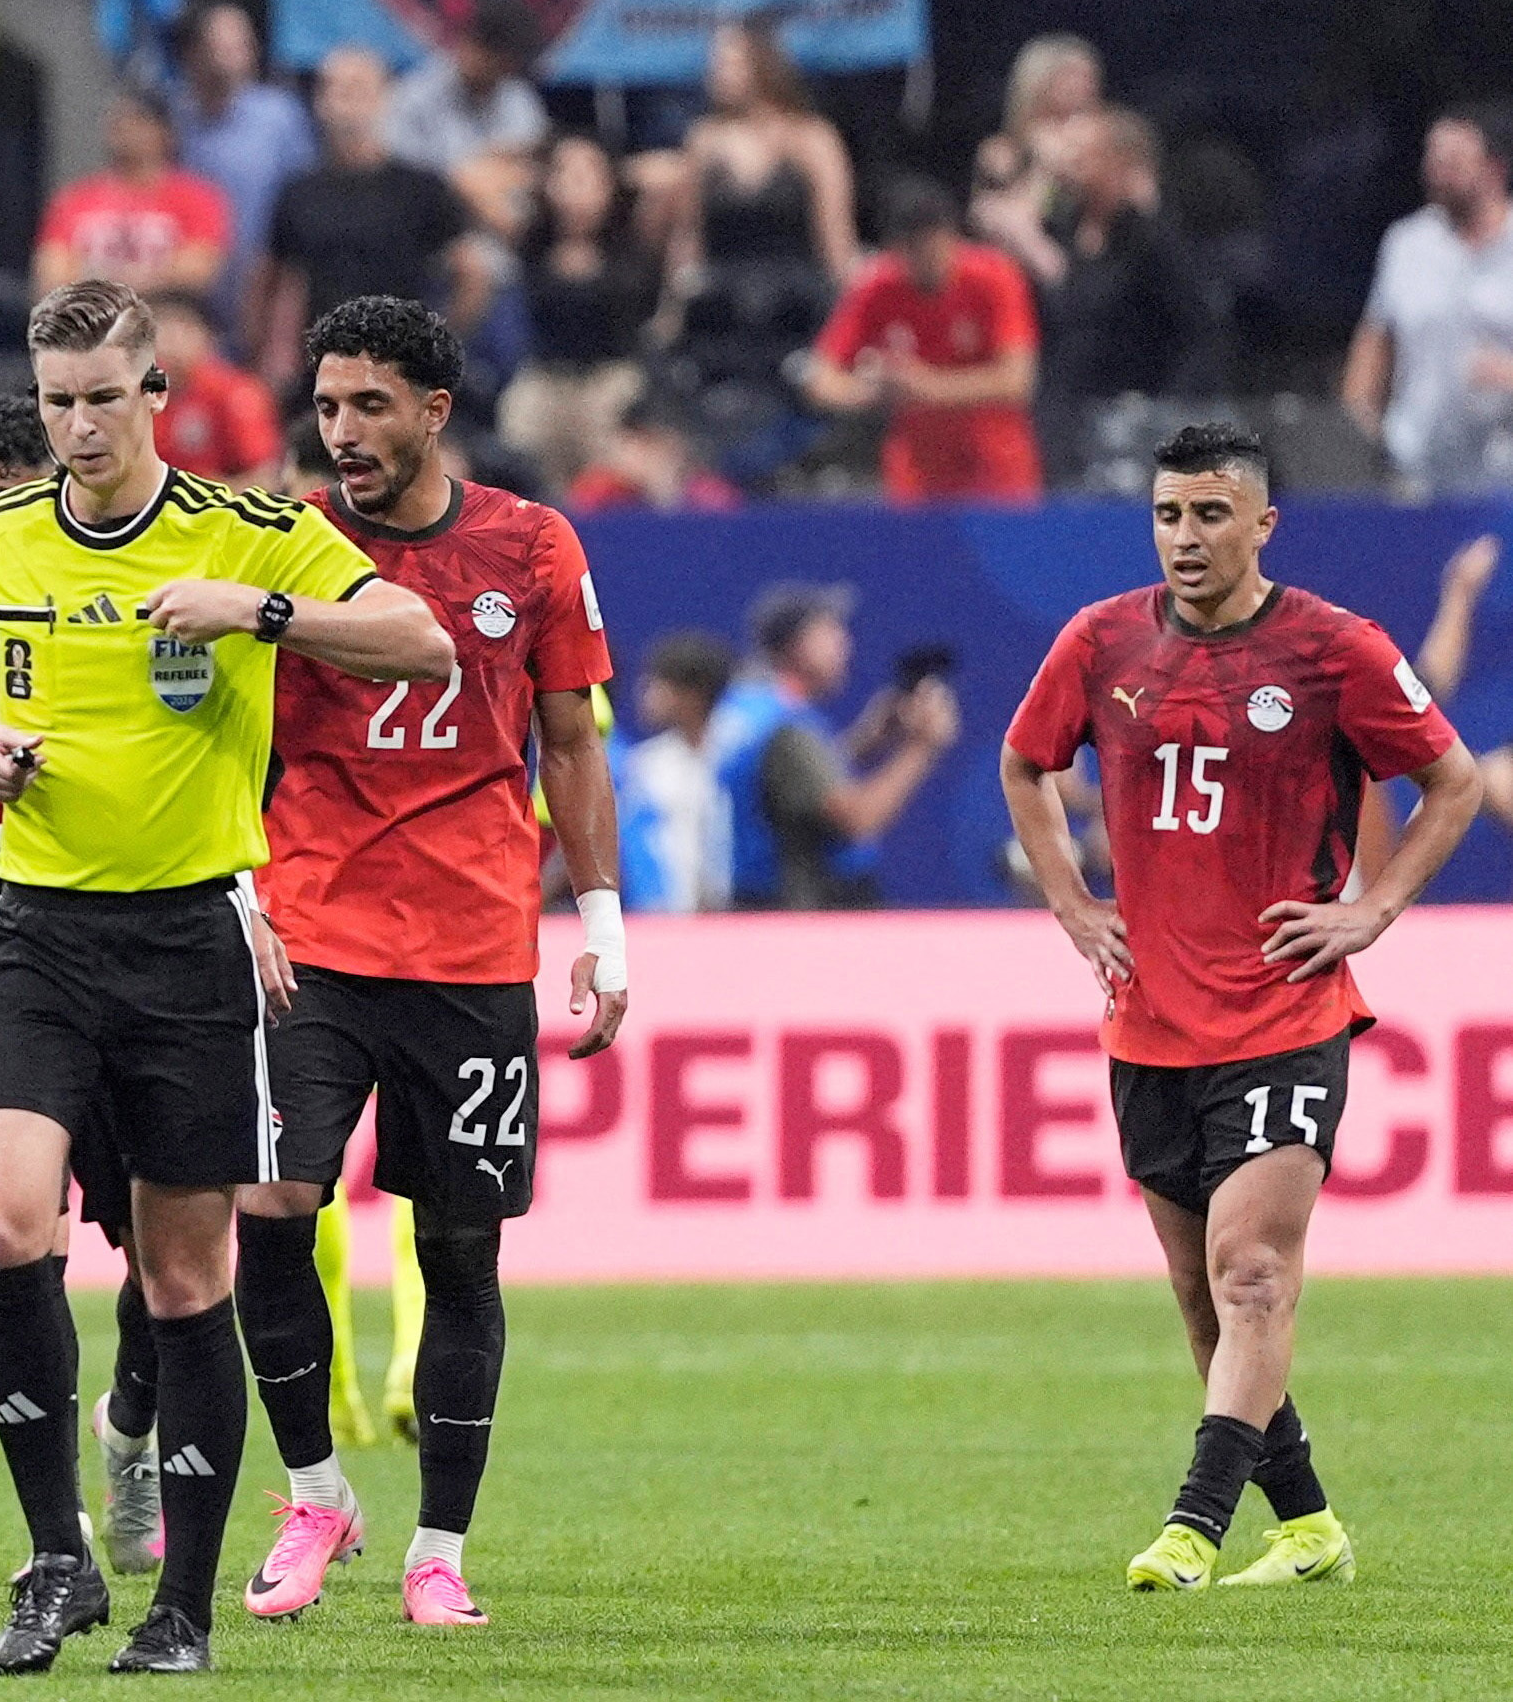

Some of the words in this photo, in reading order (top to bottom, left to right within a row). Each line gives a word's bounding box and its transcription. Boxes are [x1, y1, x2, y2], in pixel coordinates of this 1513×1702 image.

[154, 669, 209, 681] REFEREE
[155, 639, 208, 658] FIFA
[367, 660, 463, 750] 22
[1152, 743, 1230, 836] 15
[448, 1055, 527, 1147] 22
[1244, 1085, 1329, 1154] 15
